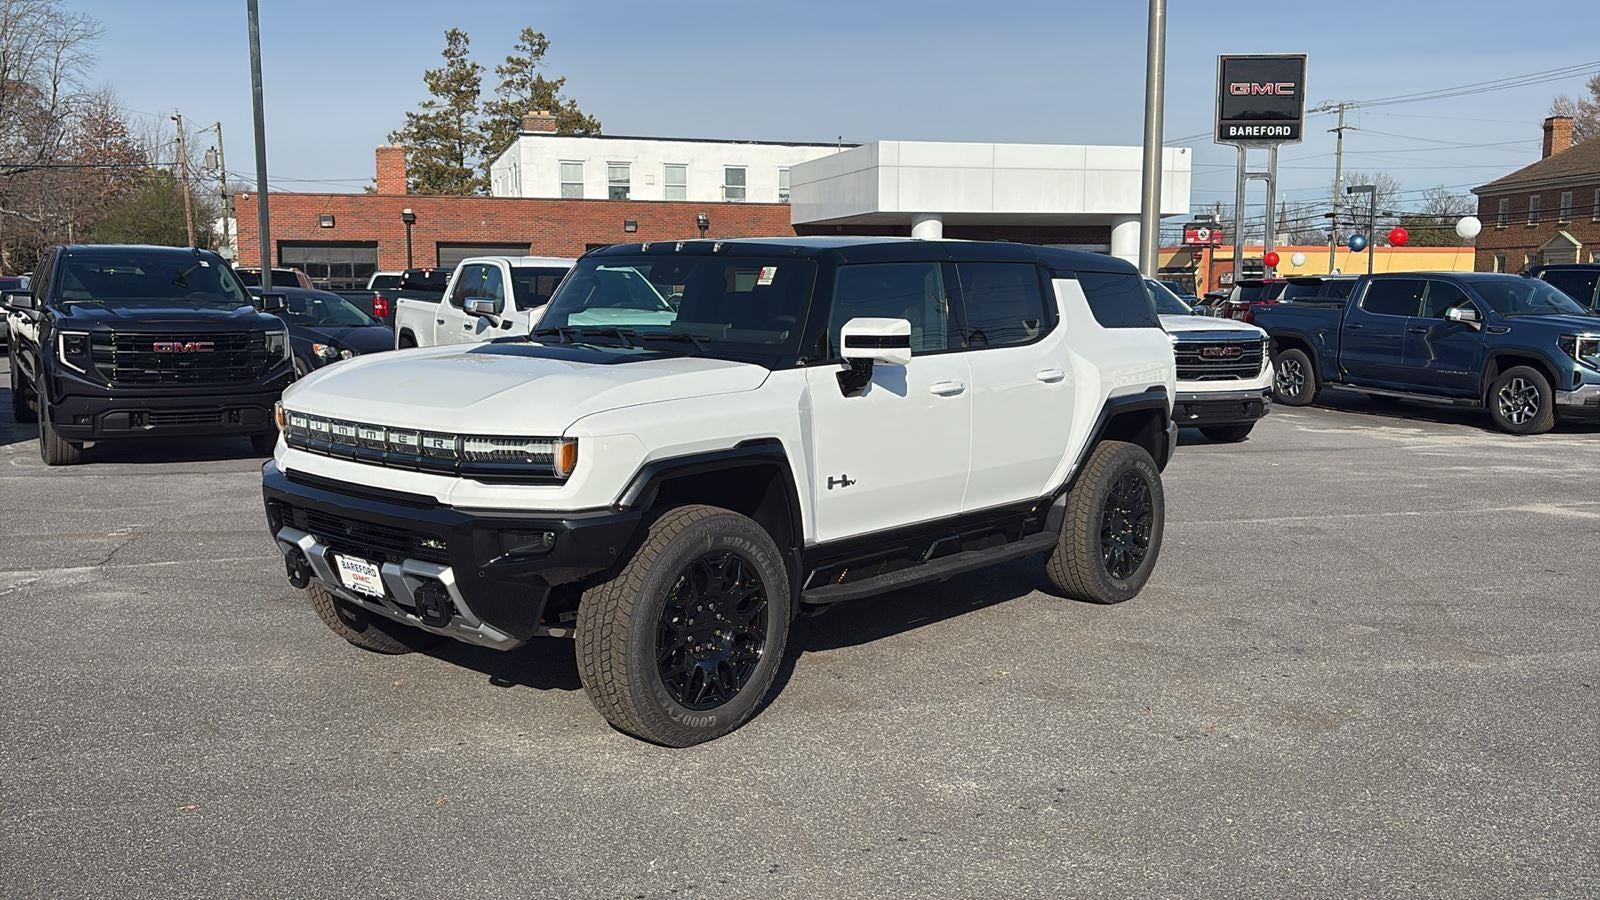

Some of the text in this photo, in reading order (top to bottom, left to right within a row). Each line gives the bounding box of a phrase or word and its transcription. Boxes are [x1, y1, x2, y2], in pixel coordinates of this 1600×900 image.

[1230, 82, 1294, 95] GMC
[1229, 125, 1291, 137] BAREFORD
[153, 341, 215, 353] GMC
[1203, 346, 1241, 357] GMC
[295, 418, 444, 448] HUMMER
[340, 560, 377, 578] BAREFORD
[352, 572, 371, 585] GMC
